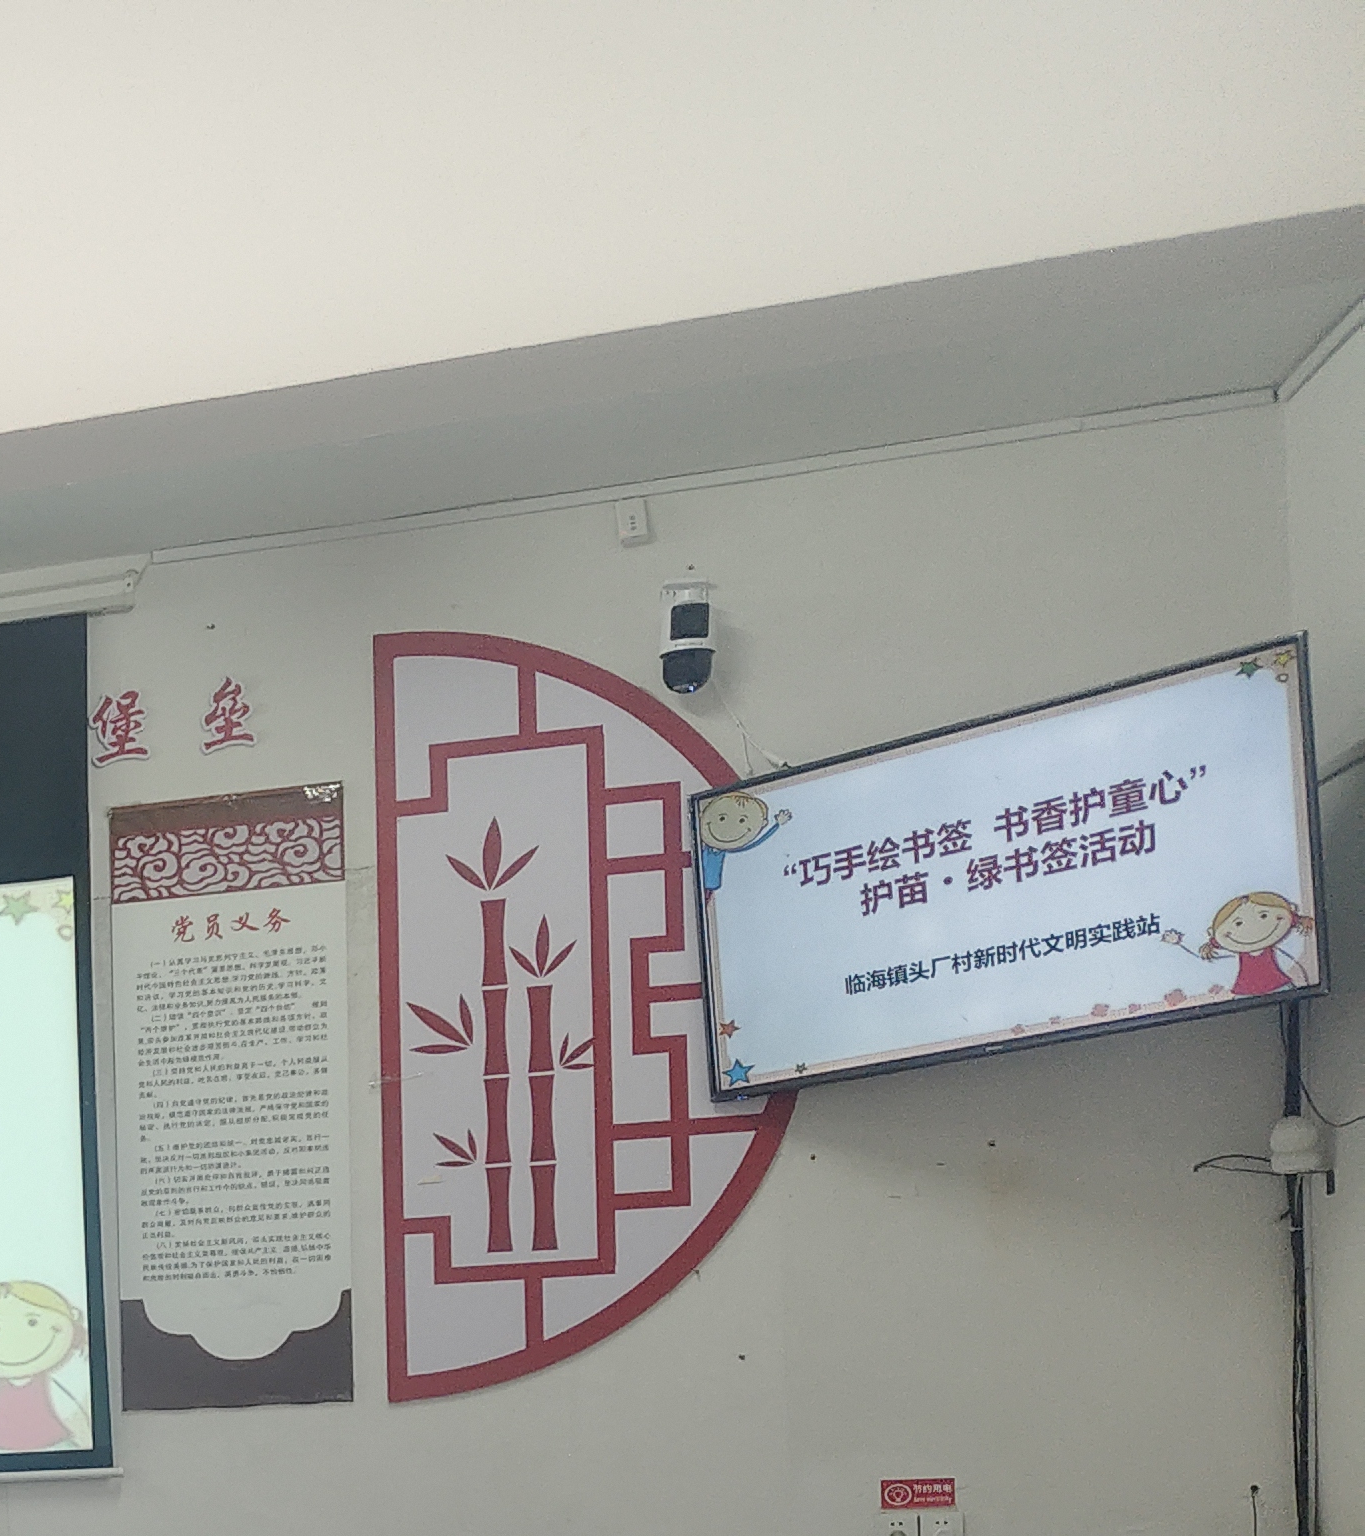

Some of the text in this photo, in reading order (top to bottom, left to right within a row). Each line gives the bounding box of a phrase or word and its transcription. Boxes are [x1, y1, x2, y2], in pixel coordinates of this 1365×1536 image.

[783, 764, 1207, 887] “巧手绘书签 书香护童心”
[171, 908, 291, 943] 党员义务
[845, 913, 1161, 996] 临海镇头厂村新时代文明实践站
